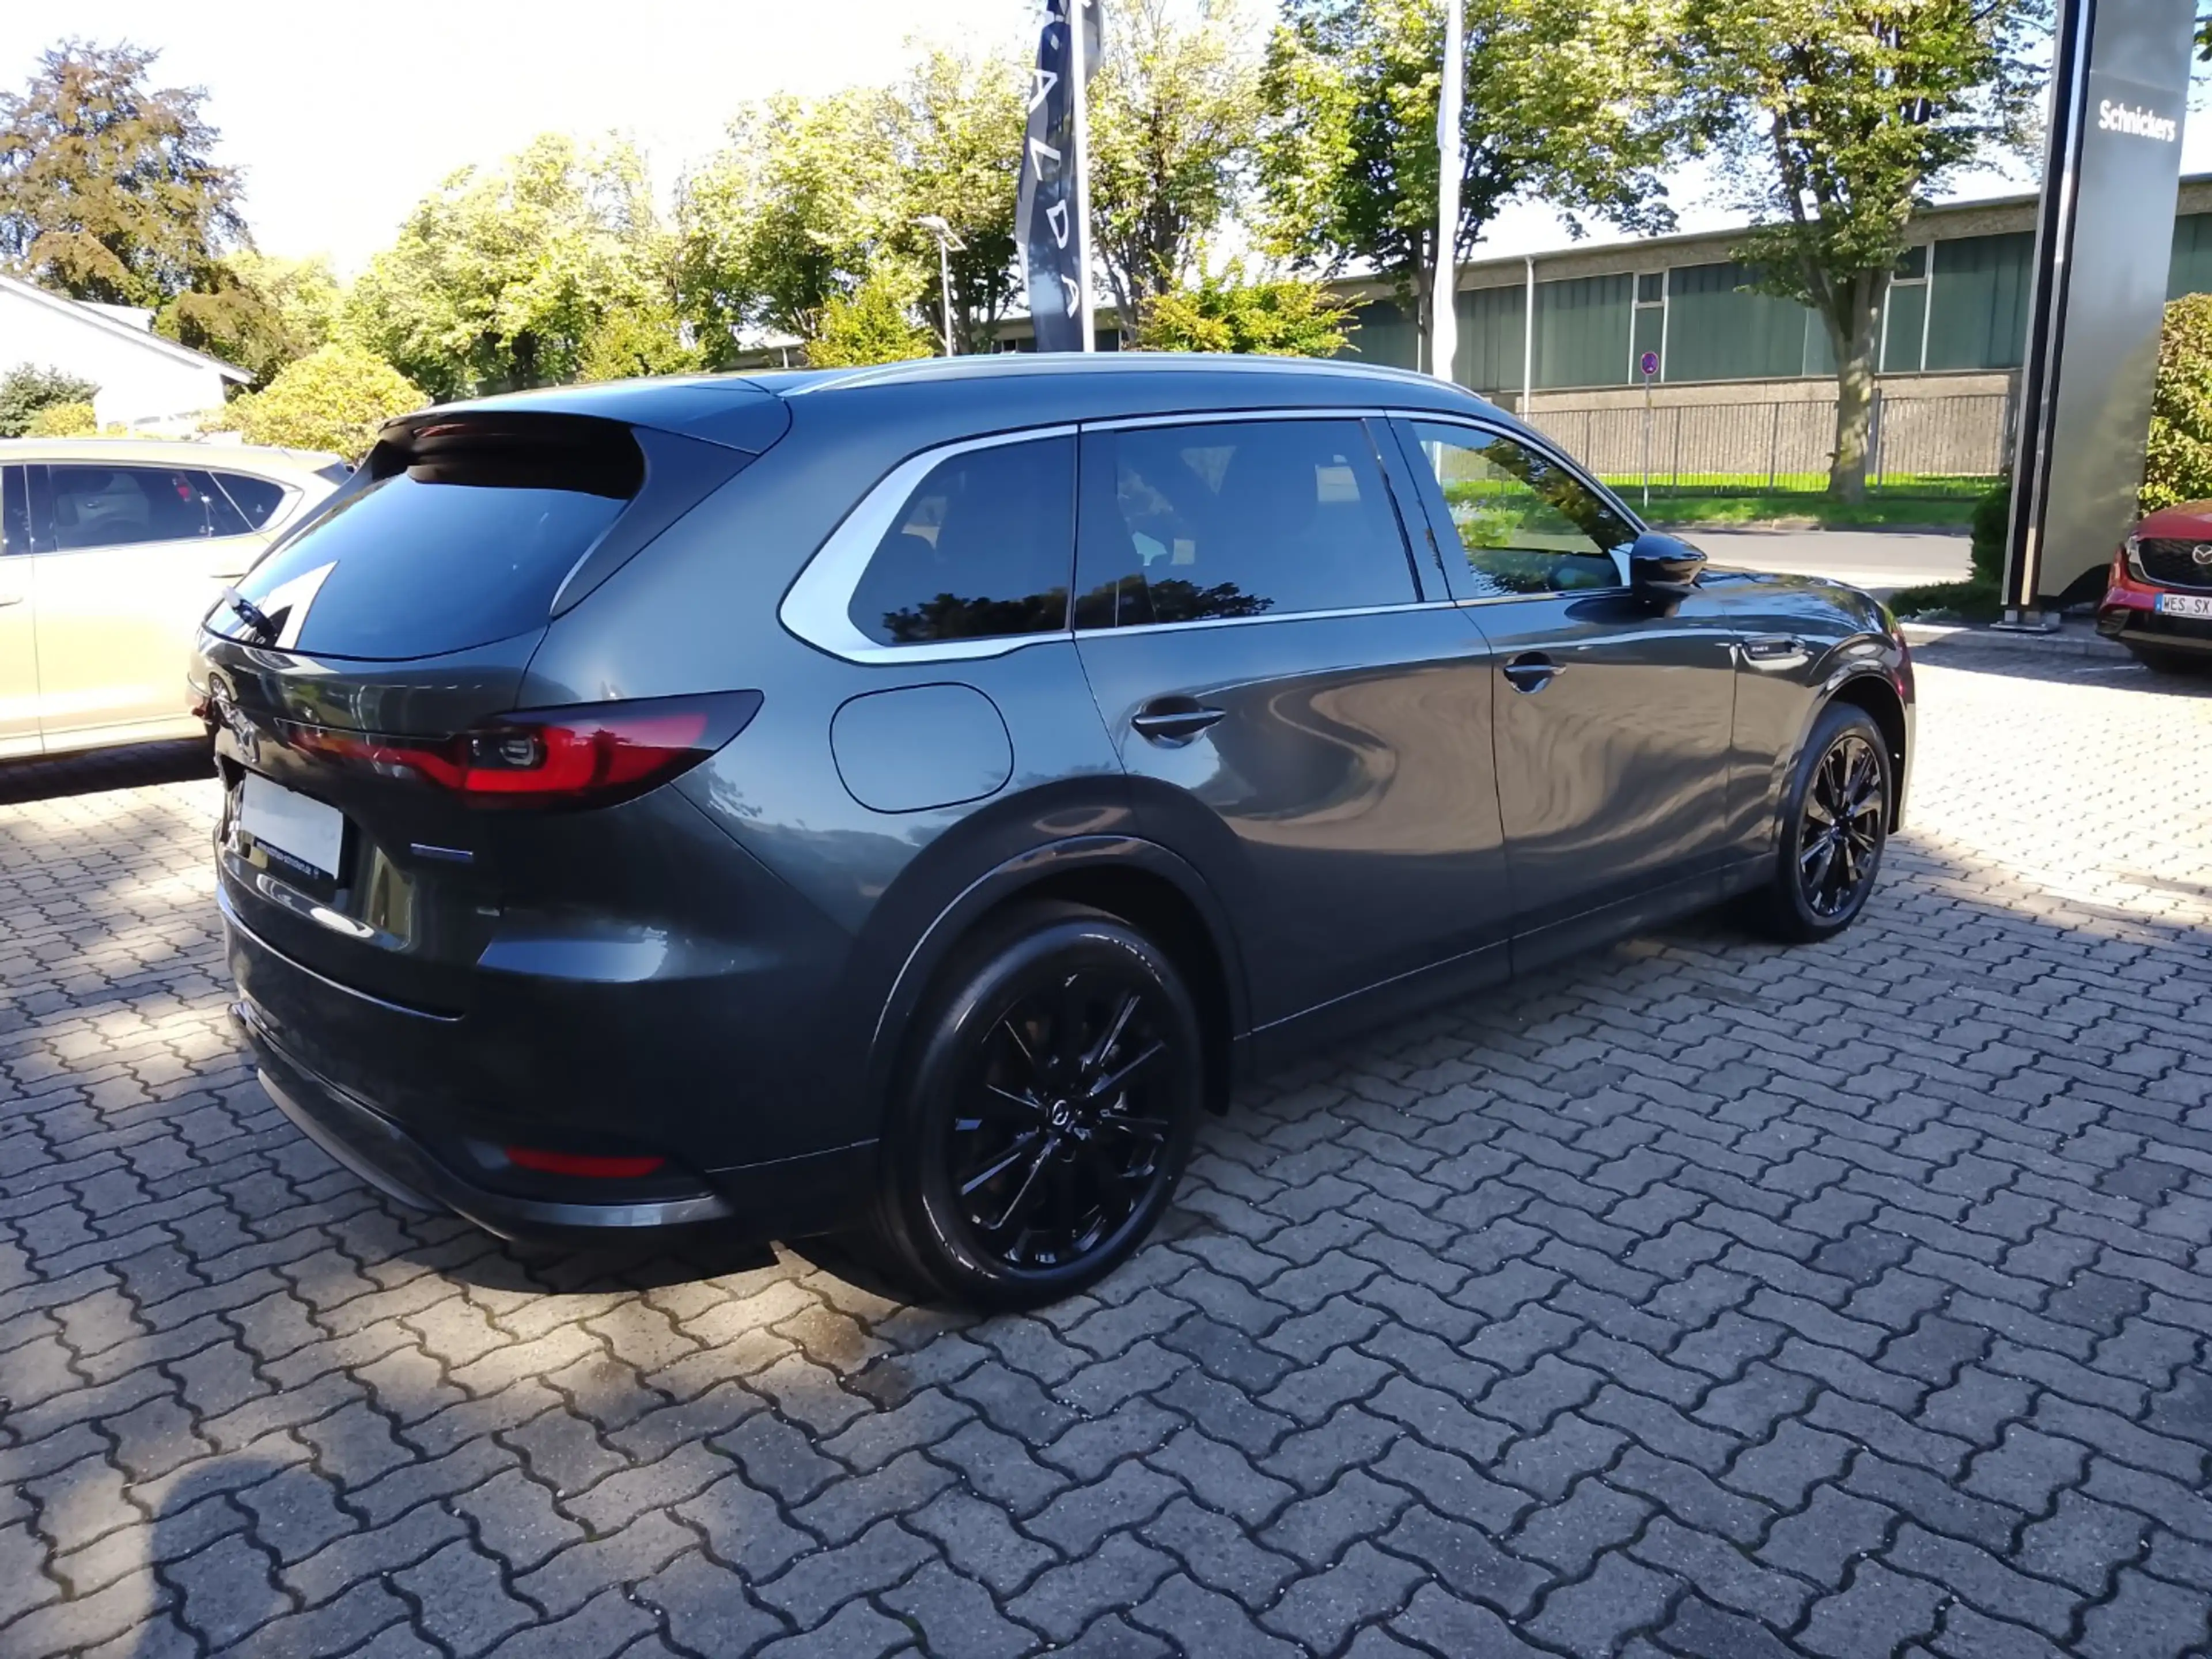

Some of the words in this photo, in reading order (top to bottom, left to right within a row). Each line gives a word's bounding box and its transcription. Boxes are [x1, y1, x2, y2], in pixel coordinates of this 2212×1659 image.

[2099, 99, 2176, 142] Schnickers
[2164, 596, 2186, 611] WES
[2194, 599, 2210, 613] SX
